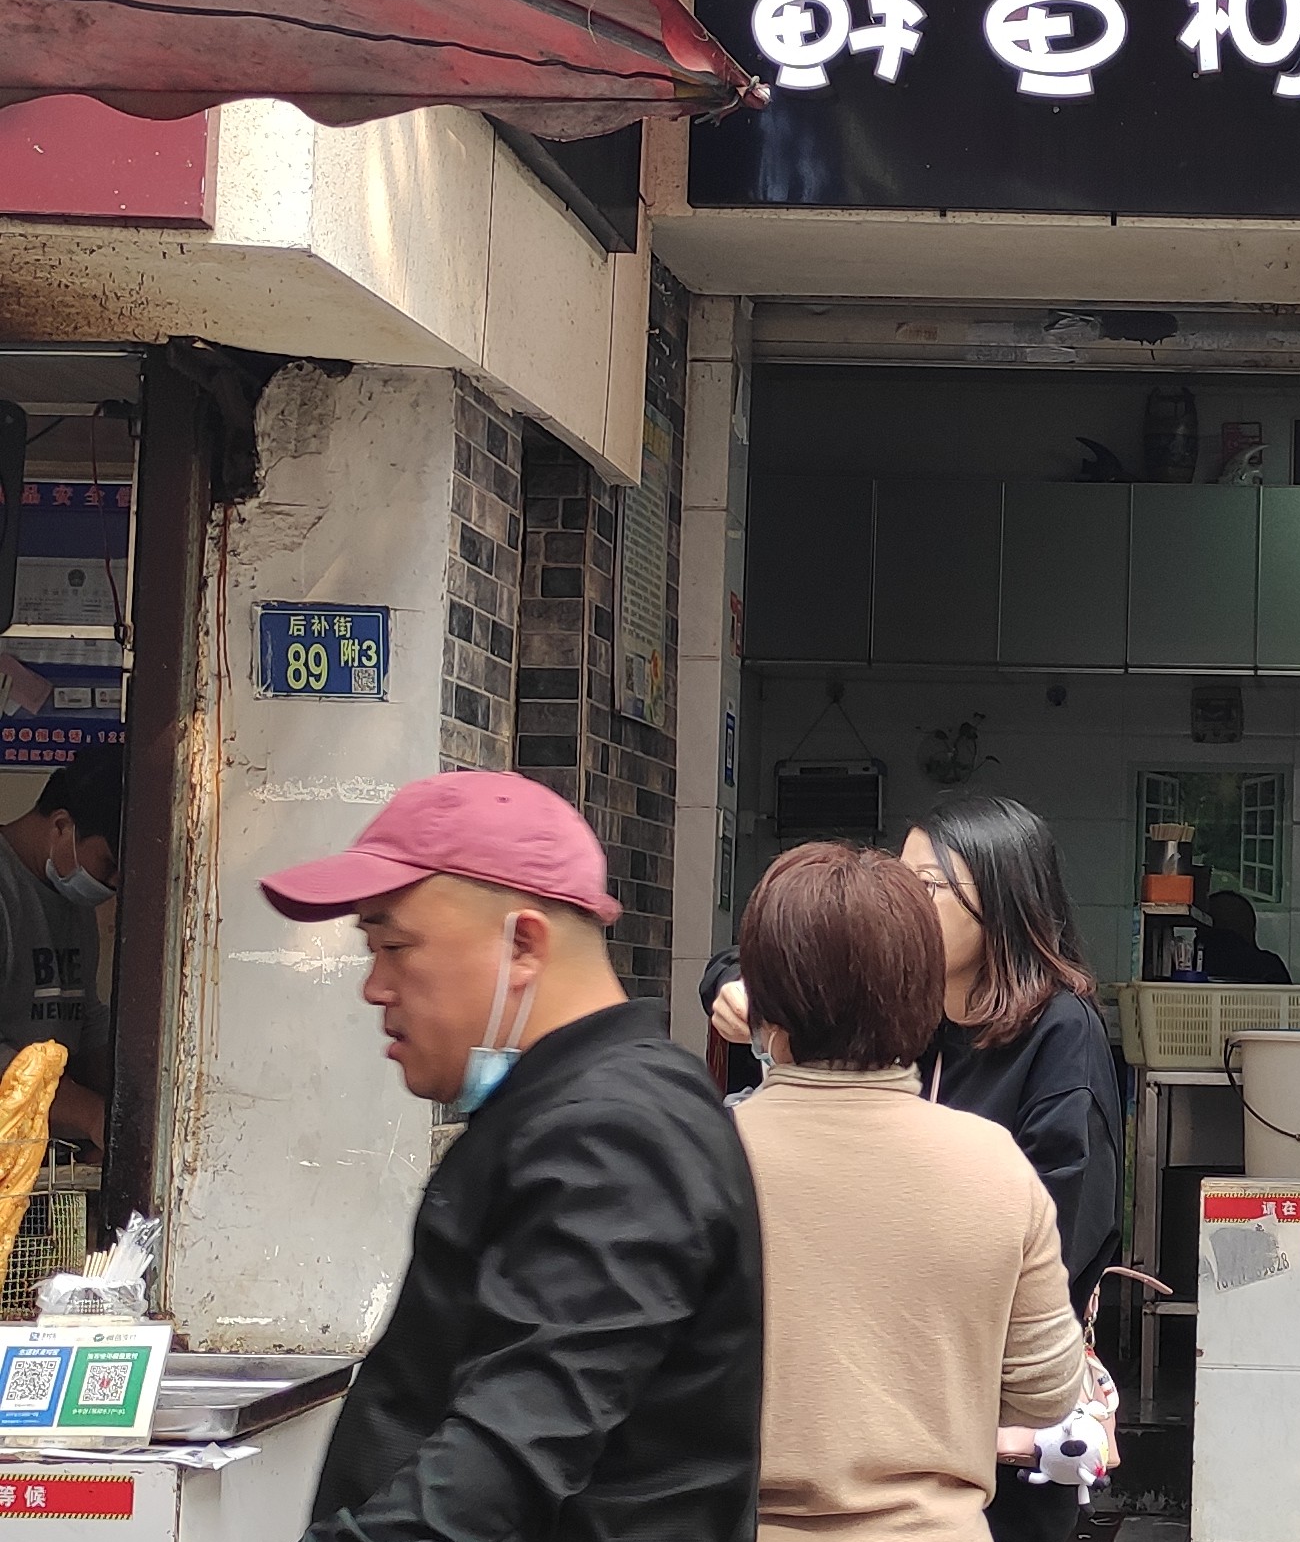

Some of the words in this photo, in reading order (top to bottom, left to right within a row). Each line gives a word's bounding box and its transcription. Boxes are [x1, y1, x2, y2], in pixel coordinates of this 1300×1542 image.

[288, 615, 353, 638] 后补街
[287, 642, 328, 690] 89
[340, 639, 378, 667] 附3
[0, 1484, 47, 1509] 等候
